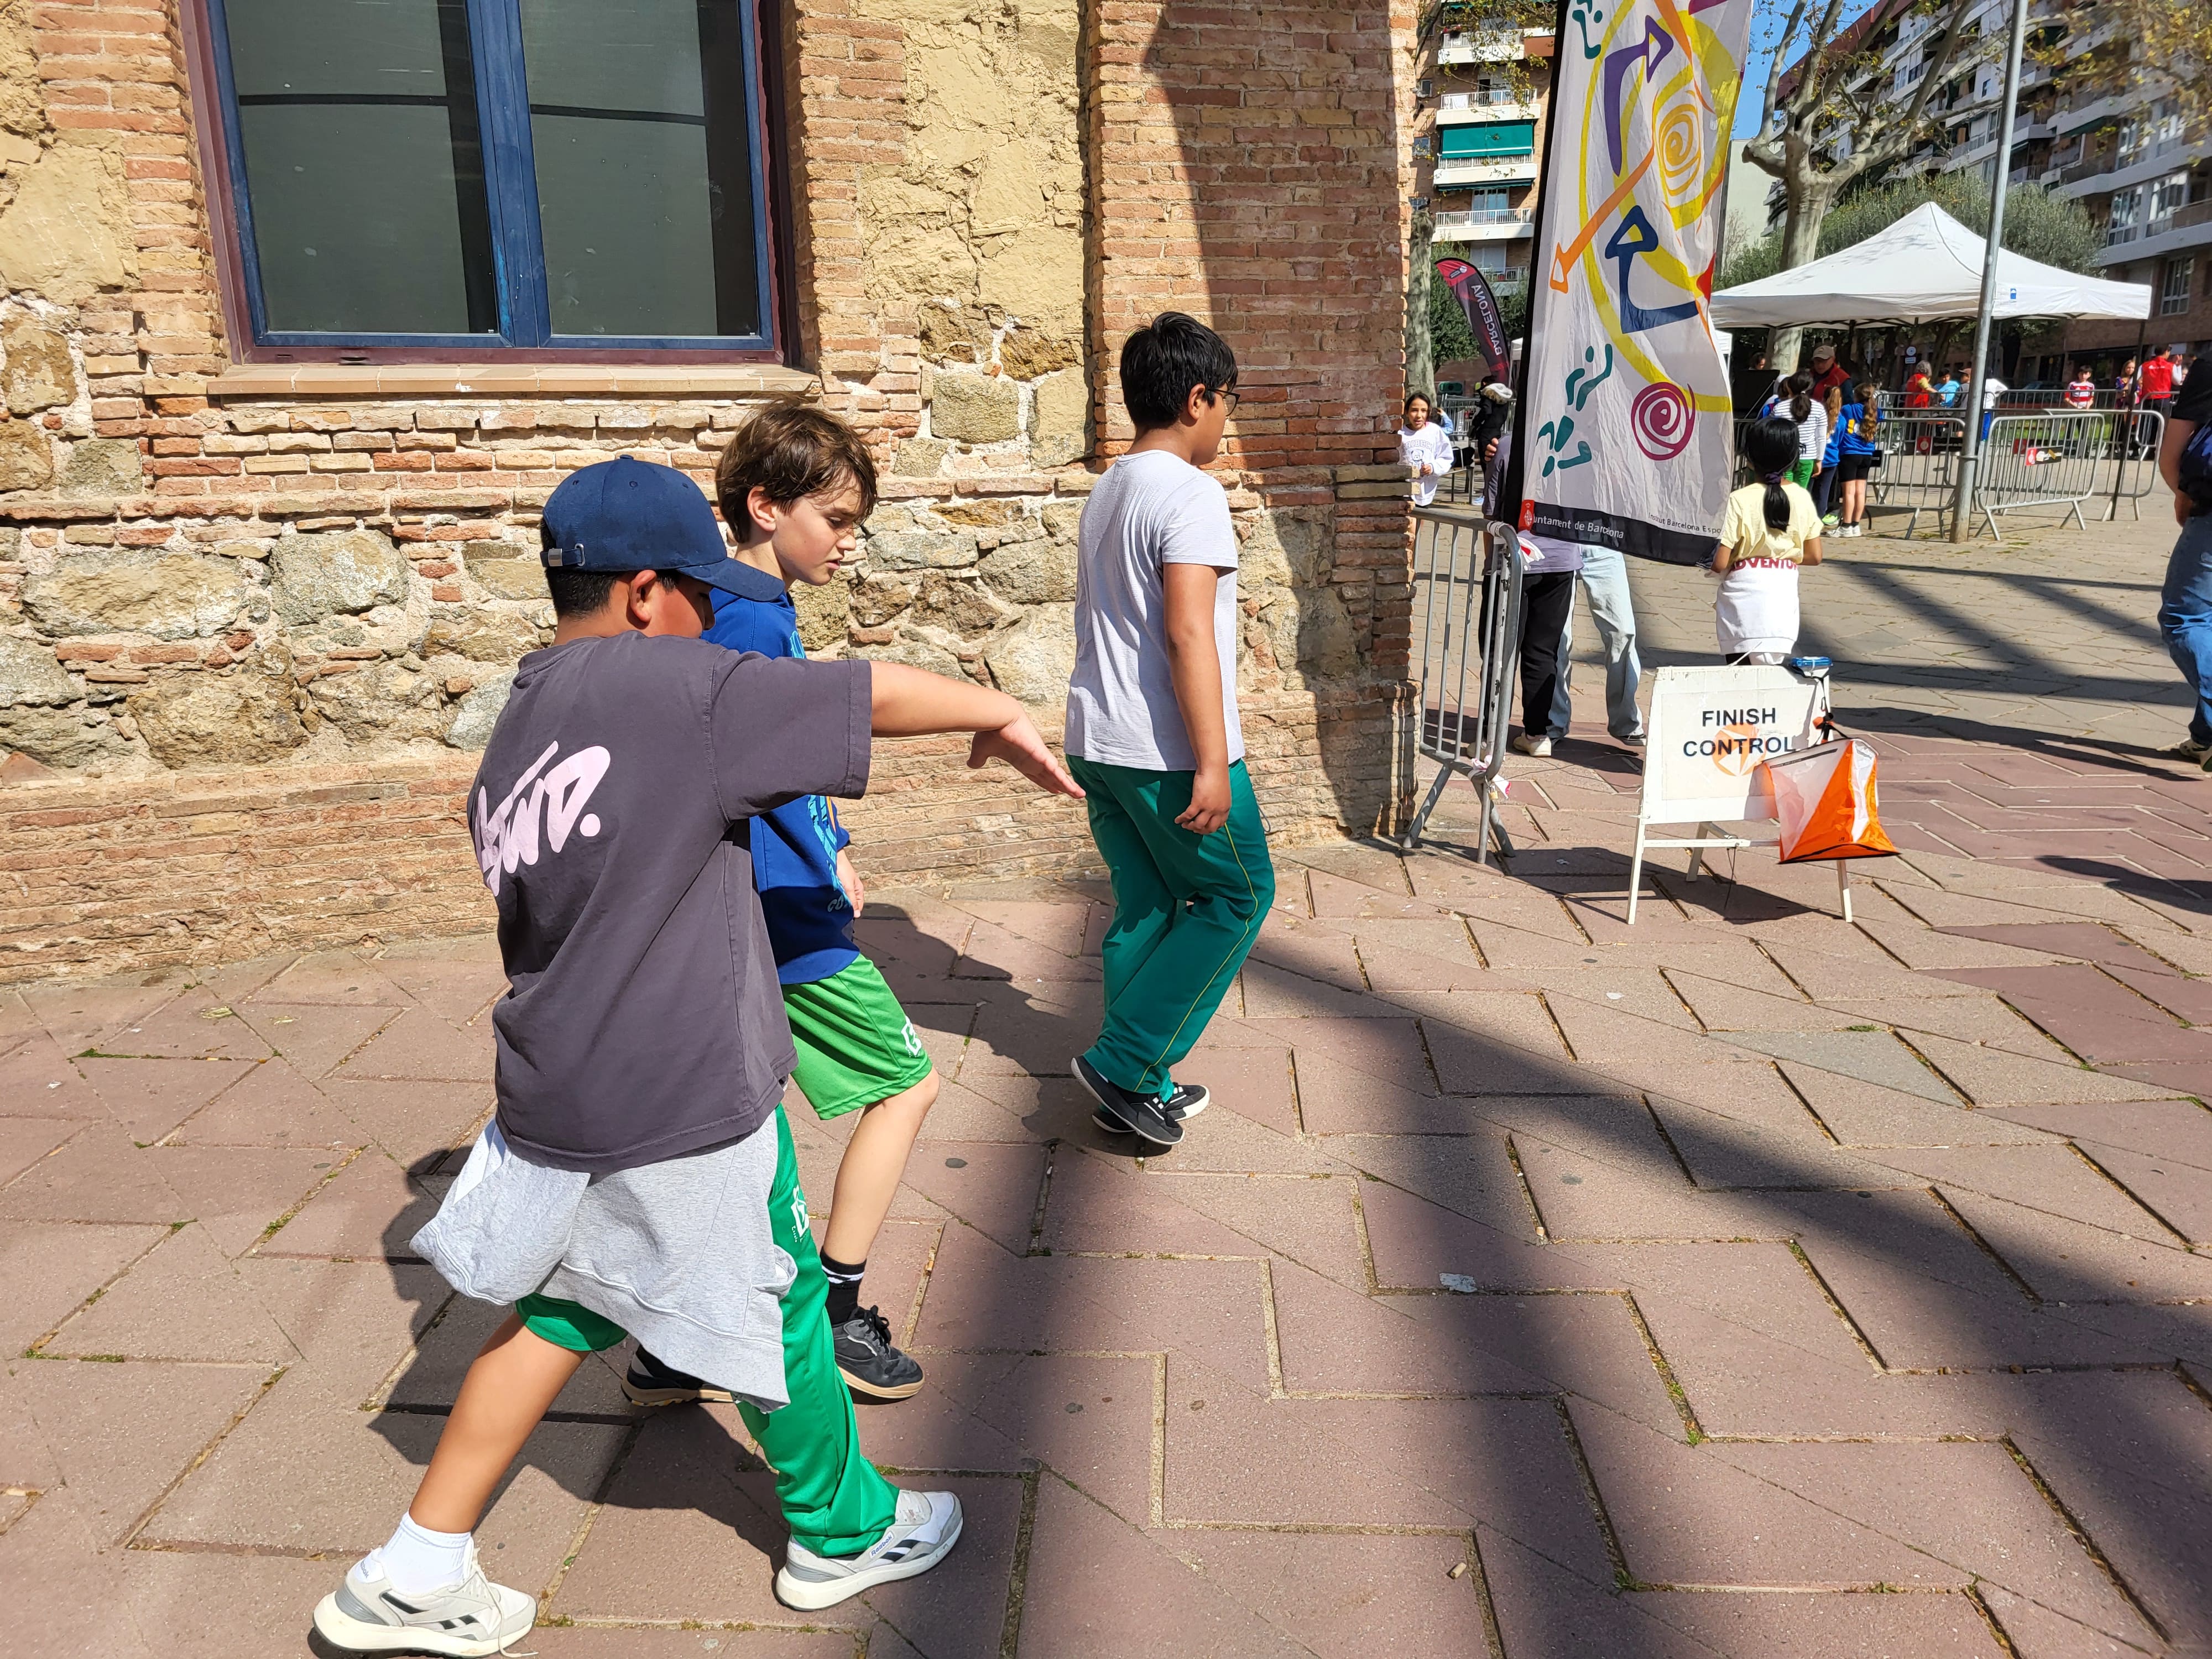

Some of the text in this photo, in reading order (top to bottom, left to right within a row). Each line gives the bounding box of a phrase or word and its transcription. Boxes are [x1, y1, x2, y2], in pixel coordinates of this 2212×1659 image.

[1533, 515, 1624, 539] untament de Barcelona
[1667, 519, 1700, 531] Barcelona
[1703, 525, 1721, 535] Espo
[1702, 707, 1776, 727] FINISH
[1683, 737, 1796, 757] CONTROL
[871, 1535, 892, 1556] Reebok
